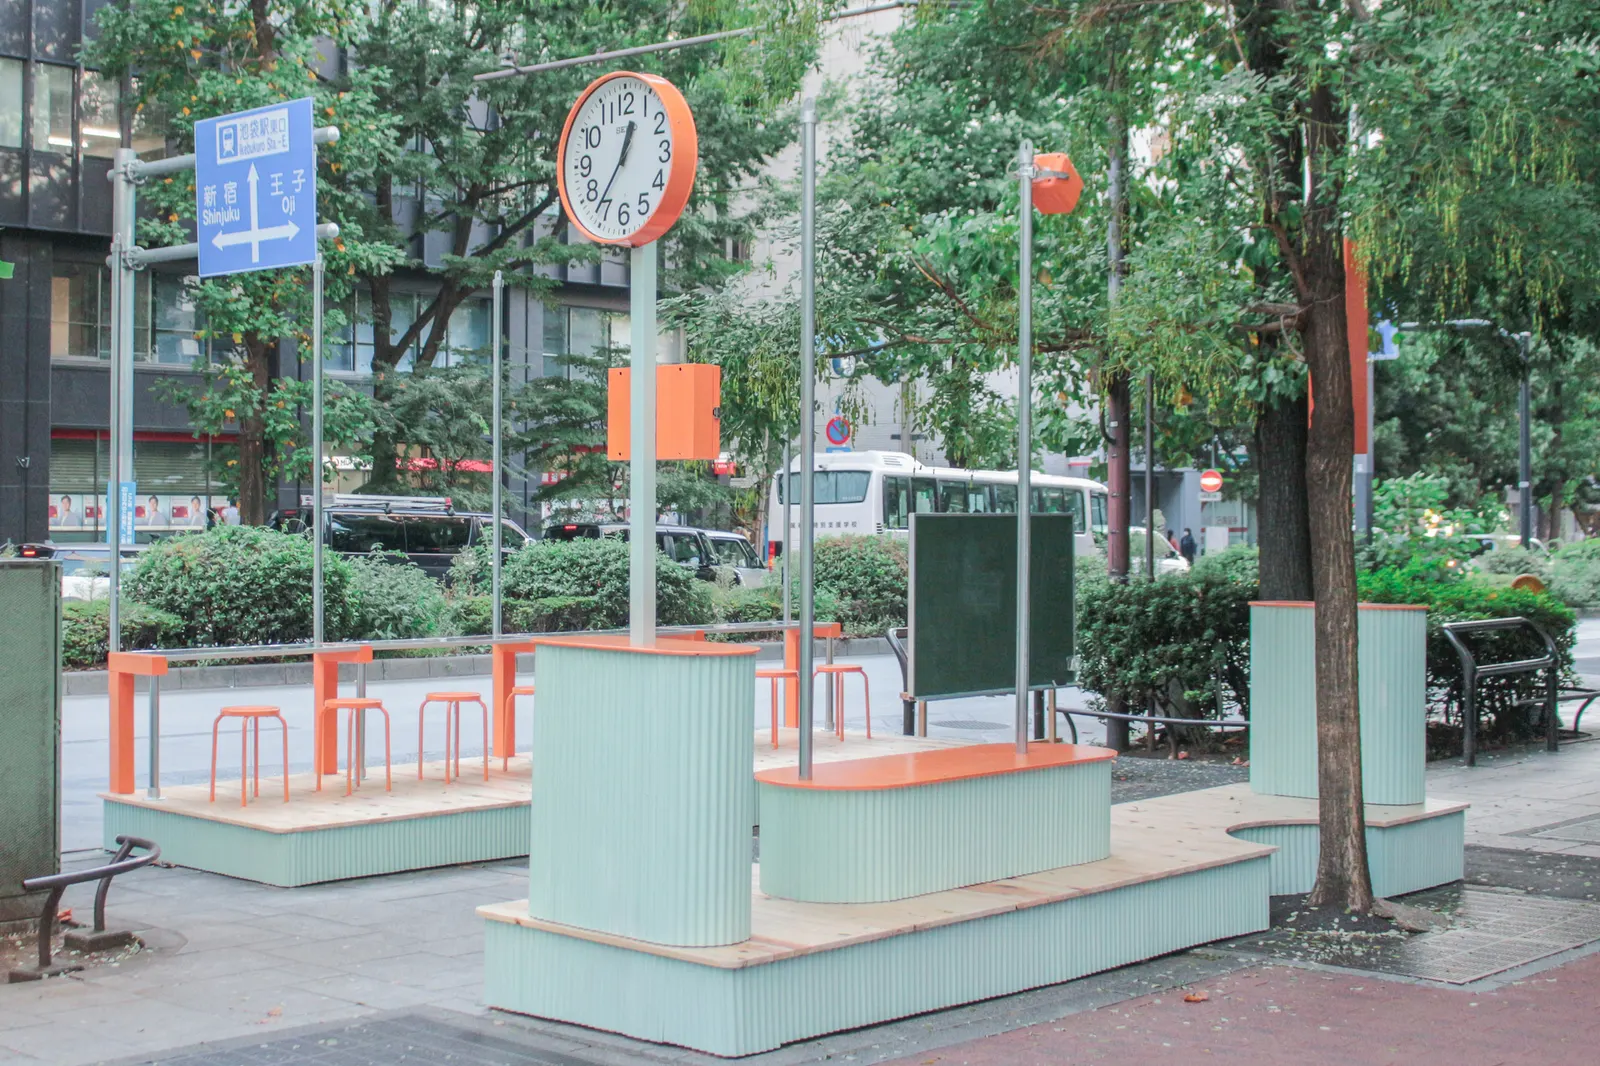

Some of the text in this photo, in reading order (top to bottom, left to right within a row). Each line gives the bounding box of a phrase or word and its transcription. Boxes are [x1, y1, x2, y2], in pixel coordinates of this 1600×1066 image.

[602, 102, 613, 125] 11
[618, 92, 635, 116] 12
[643, 95, 647, 117] 1
[239, 117, 286, 140] 池袋駅東口
[616, 124, 637, 134] SEO
[654, 111, 665, 135] 2
[586, 125, 601, 149] 10
[658, 139, 671, 164] 3
[580, 154, 592, 178] 9
[270, 169, 306, 196] 王子
[586, 178, 598, 202] 8
[652, 168, 665, 192] 4
[204, 181, 238, 207] 新宿
[282, 196, 295, 216] Oji
[637, 192, 650, 216] 5
[203, 206, 240, 226] Shinjuku
[602, 198, 613, 222] 7
[618, 202, 630, 226] 6
